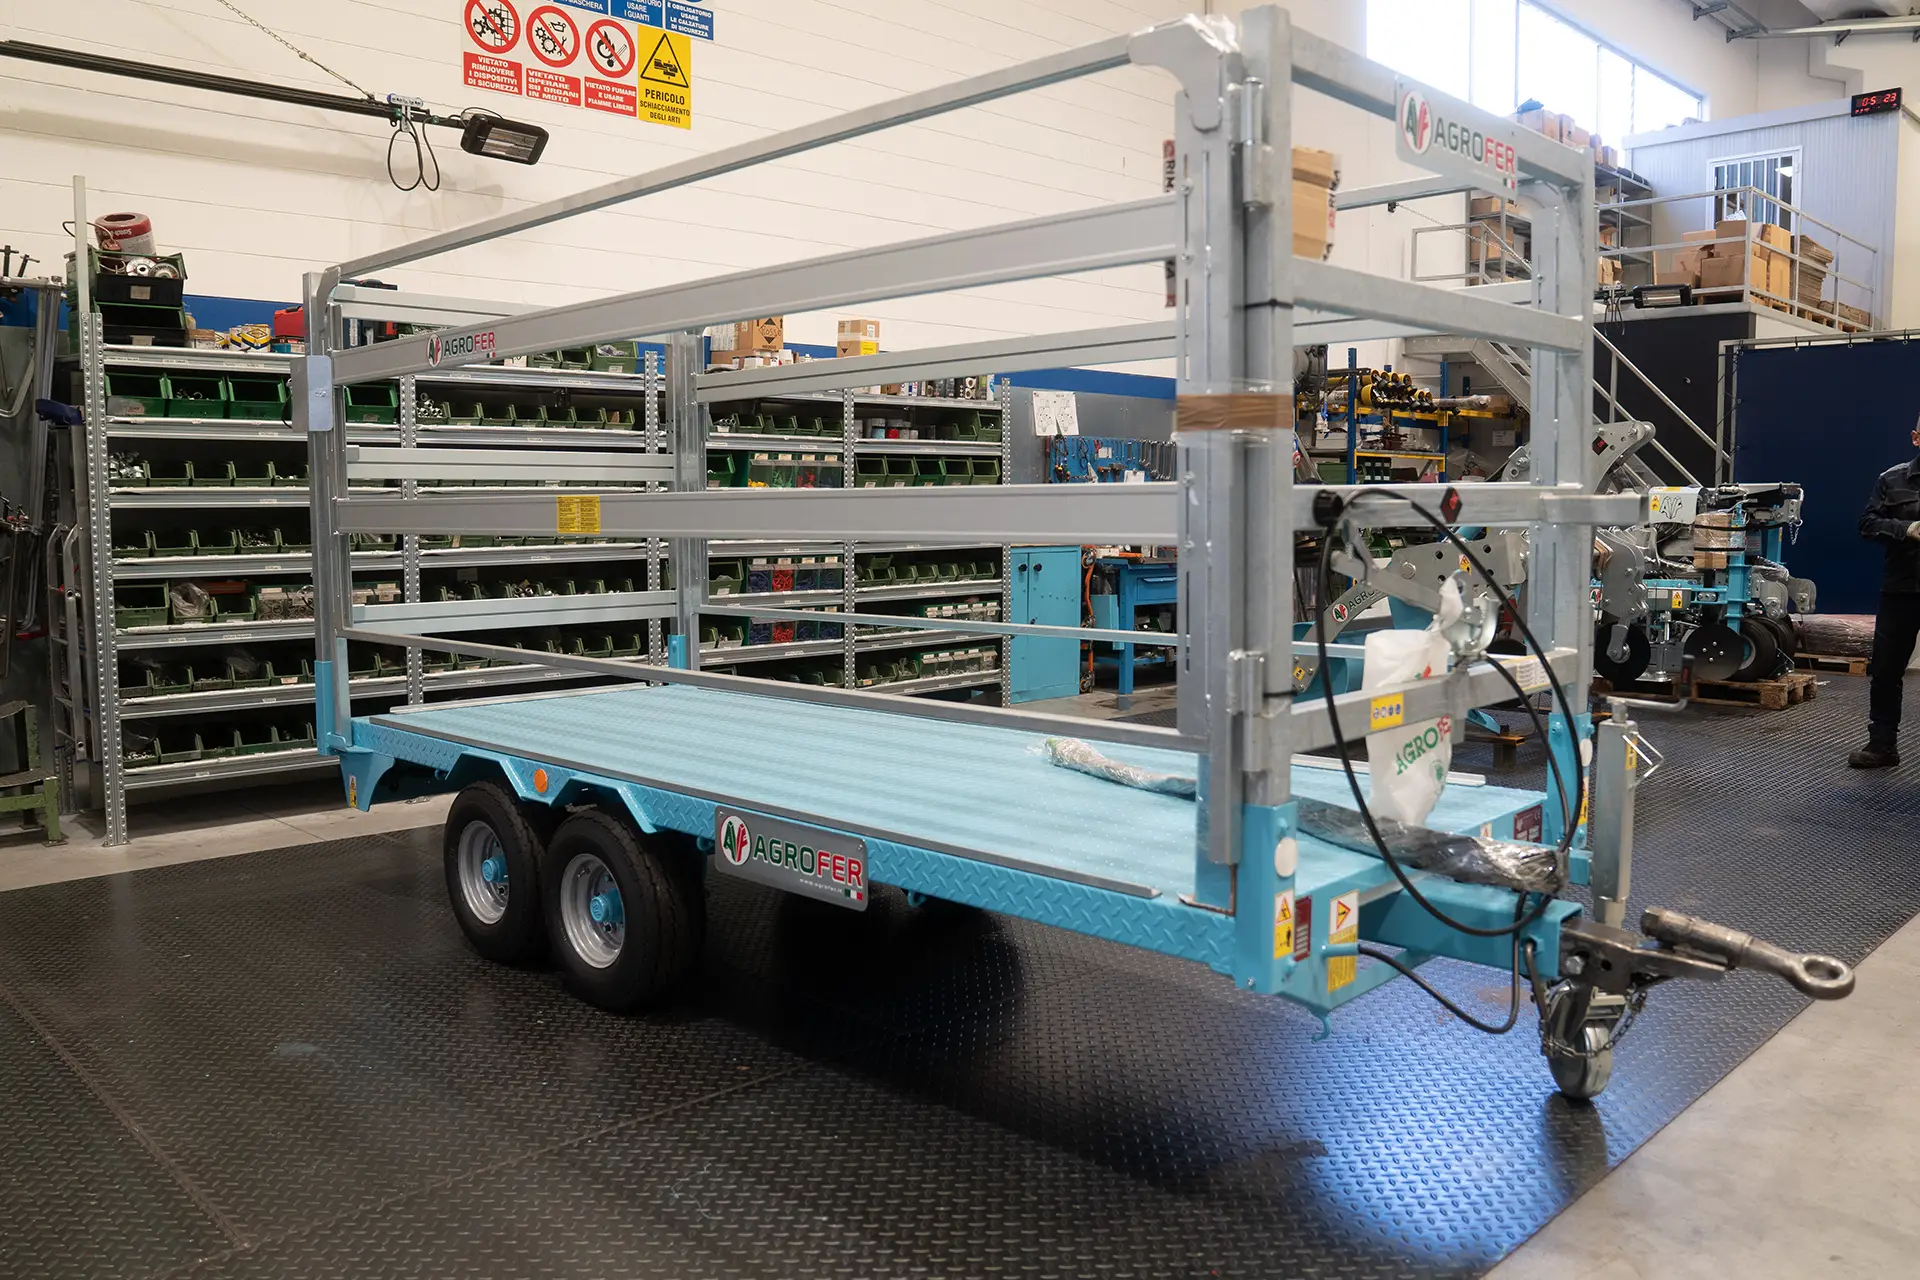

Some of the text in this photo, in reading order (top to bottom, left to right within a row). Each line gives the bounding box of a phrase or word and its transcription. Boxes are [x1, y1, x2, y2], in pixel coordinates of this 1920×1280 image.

[626, 2, 647, 13] USARE
[672, 3, 712, 18] OBBLIGATORIO
[628, 10, 650, 22] GUANTI
[680, 12, 699, 22] USARE
[678, 18, 709, 31] CALZATURE
[678, 25, 709, 38] SICUREZZA
[478, 56, 508, 68] VIETATO
[472, 63, 515, 77] RIMUOVERE
[528, 70, 565, 82] VIETATO
[474, 71, 518, 85] DISPOSITIVI
[528, 78, 570, 90] OPERARE
[478, 80, 519, 93] SICUREZZA
[544, 87, 579, 98] ORGANI
[586, 82, 636, 97] VIETATO FUMARE
[542, 95, 569, 103] MOTO
[604, 93, 624, 102] USARE
[645, 89, 685, 105] PERICOLO
[588, 98, 634, 112] FIAMME LIBERE
[640, 100, 690, 116] SCHIACCIAMENTO
[650, 112, 681, 124] DEGLI ARTI
[1434, 116, 1515, 175] AGROFER
[444, 332, 496, 357] AGROFER
[1348, 589, 1379, 611] AGRO
[752, 834, 864, 889] AGROFER
[799, 878, 843, 894] www.agrofer.it
